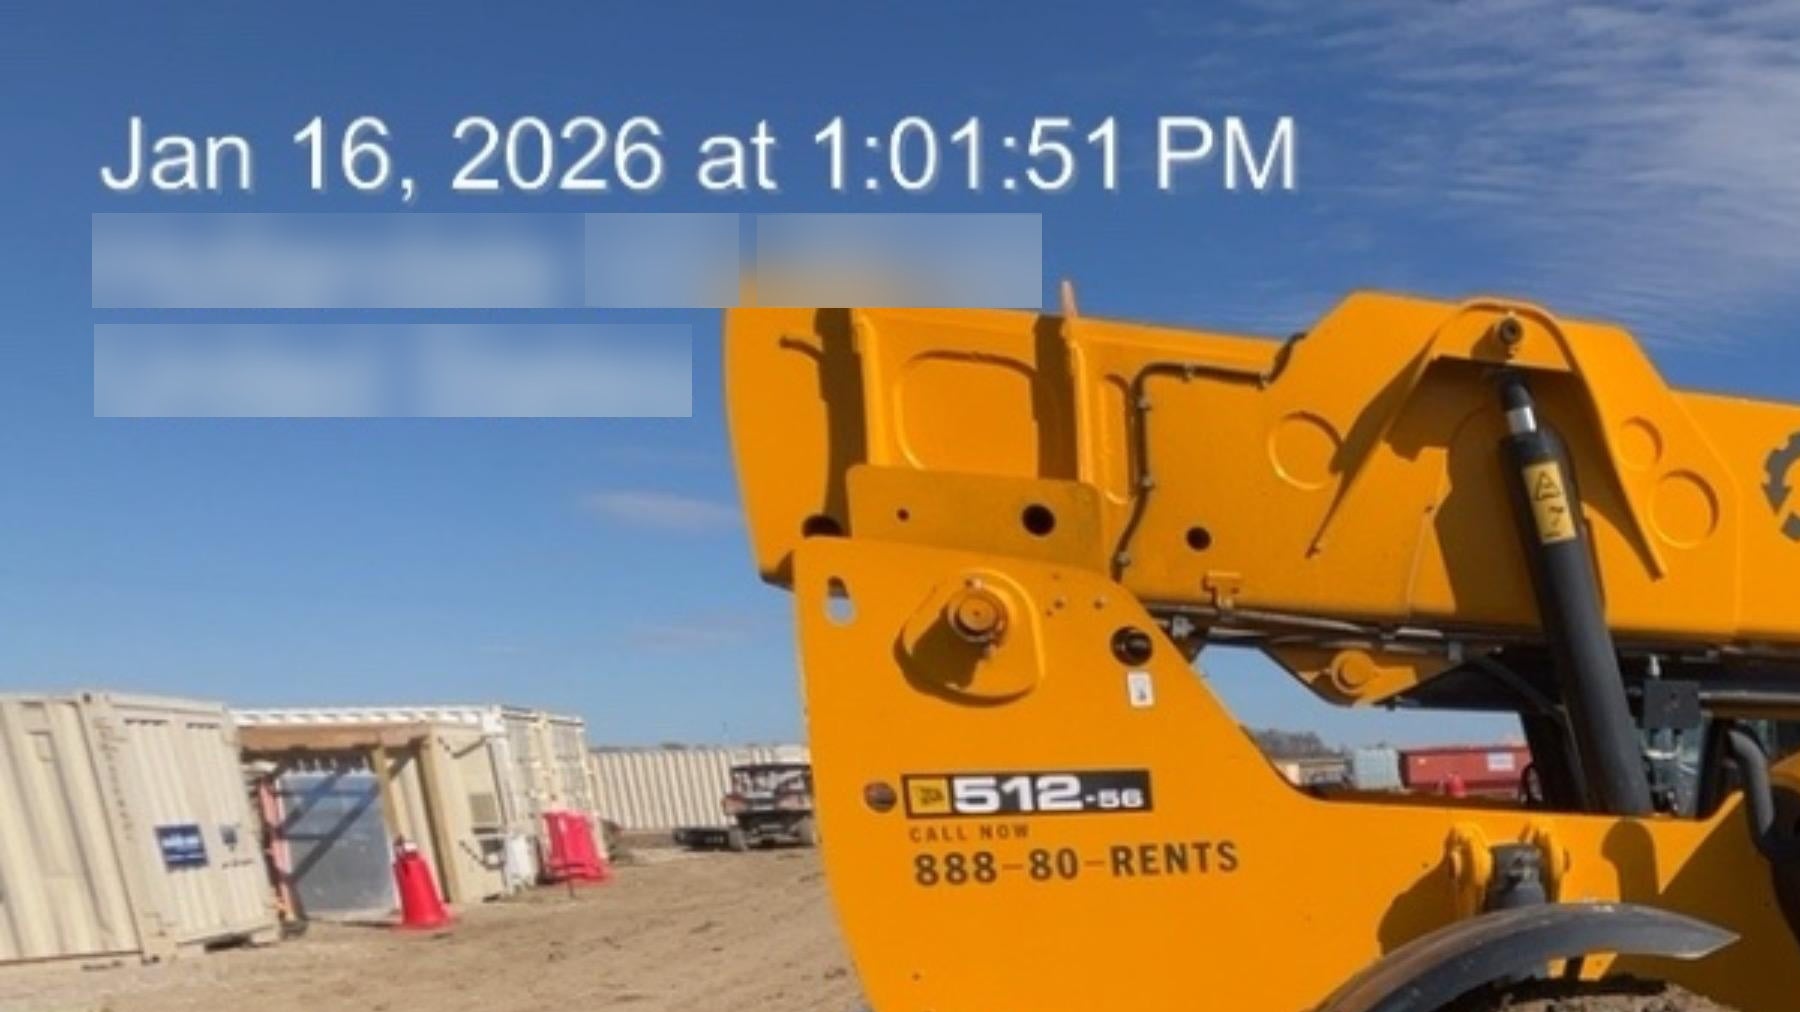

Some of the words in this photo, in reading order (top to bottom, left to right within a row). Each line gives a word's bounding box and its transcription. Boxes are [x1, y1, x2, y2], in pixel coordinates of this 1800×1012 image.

[909, 826, 968, 843] CALL
[979, 824, 1030, 840] NOW
[914, 840, 1239, 887] 888-80-RENTS
